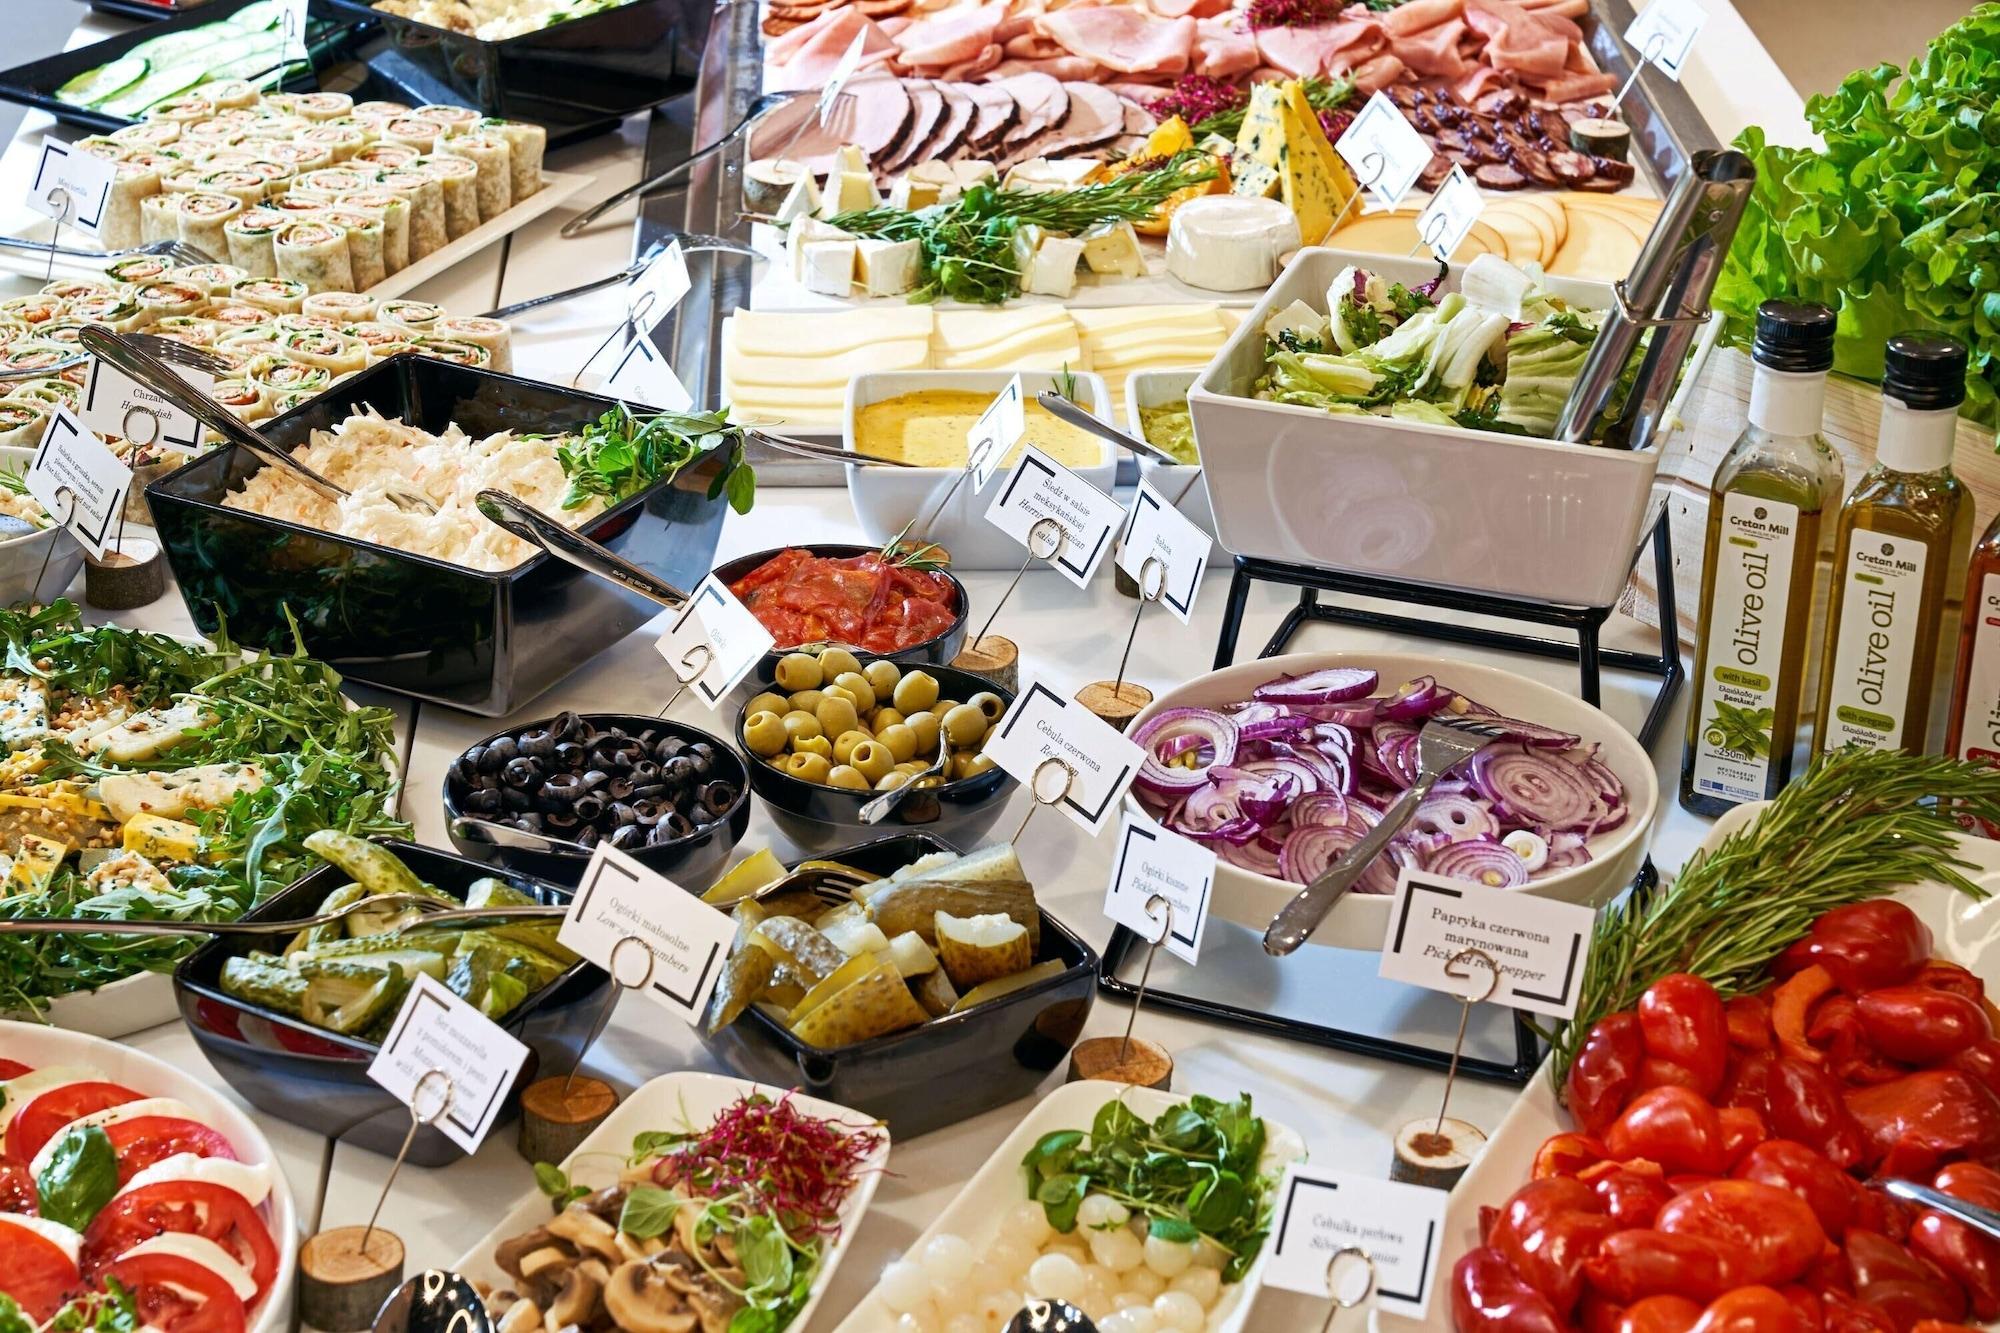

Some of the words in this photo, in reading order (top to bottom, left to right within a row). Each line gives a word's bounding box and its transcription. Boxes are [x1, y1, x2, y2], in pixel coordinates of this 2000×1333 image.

[133, 388, 164, 403] Chrzan
[1018, 498, 1047, 522] Herrin
[1034, 492, 1086, 532] meksykańskiej
[1064, 494, 1070, 502] w
[1070, 500, 1090, 516] salsie
[1036, 530, 1056, 546] salsa
[1730, 516, 1766, 530] Cretan
[1769, 524, 1789, 536] Mill
[1742, 552, 1768, 590] oil
[1856, 552, 1892, 567] Cretan
[1896, 560, 1916, 572] Mill
[1868, 590, 1896, 628] oil
[1733, 594, 1764, 666] olive
[1722, 672, 1740, 681] with
[1742, 676, 1761, 687] basil
[1857, 632, 1890, 706] olive
[1036, 719, 1064, 744] Cebula
[1064, 742, 1100, 772] czerwona
[610, 897, 641, 924] Ogórki
[642, 918, 690, 952] małosolne
[1431, 907, 1486, 929] Papryka
[1490, 923, 1550, 944] czerwona
[1424, 944, 1473, 965] Picked
[1500, 964, 1546, 981] pepper
[1444, 932, 1529, 958] marynowana
